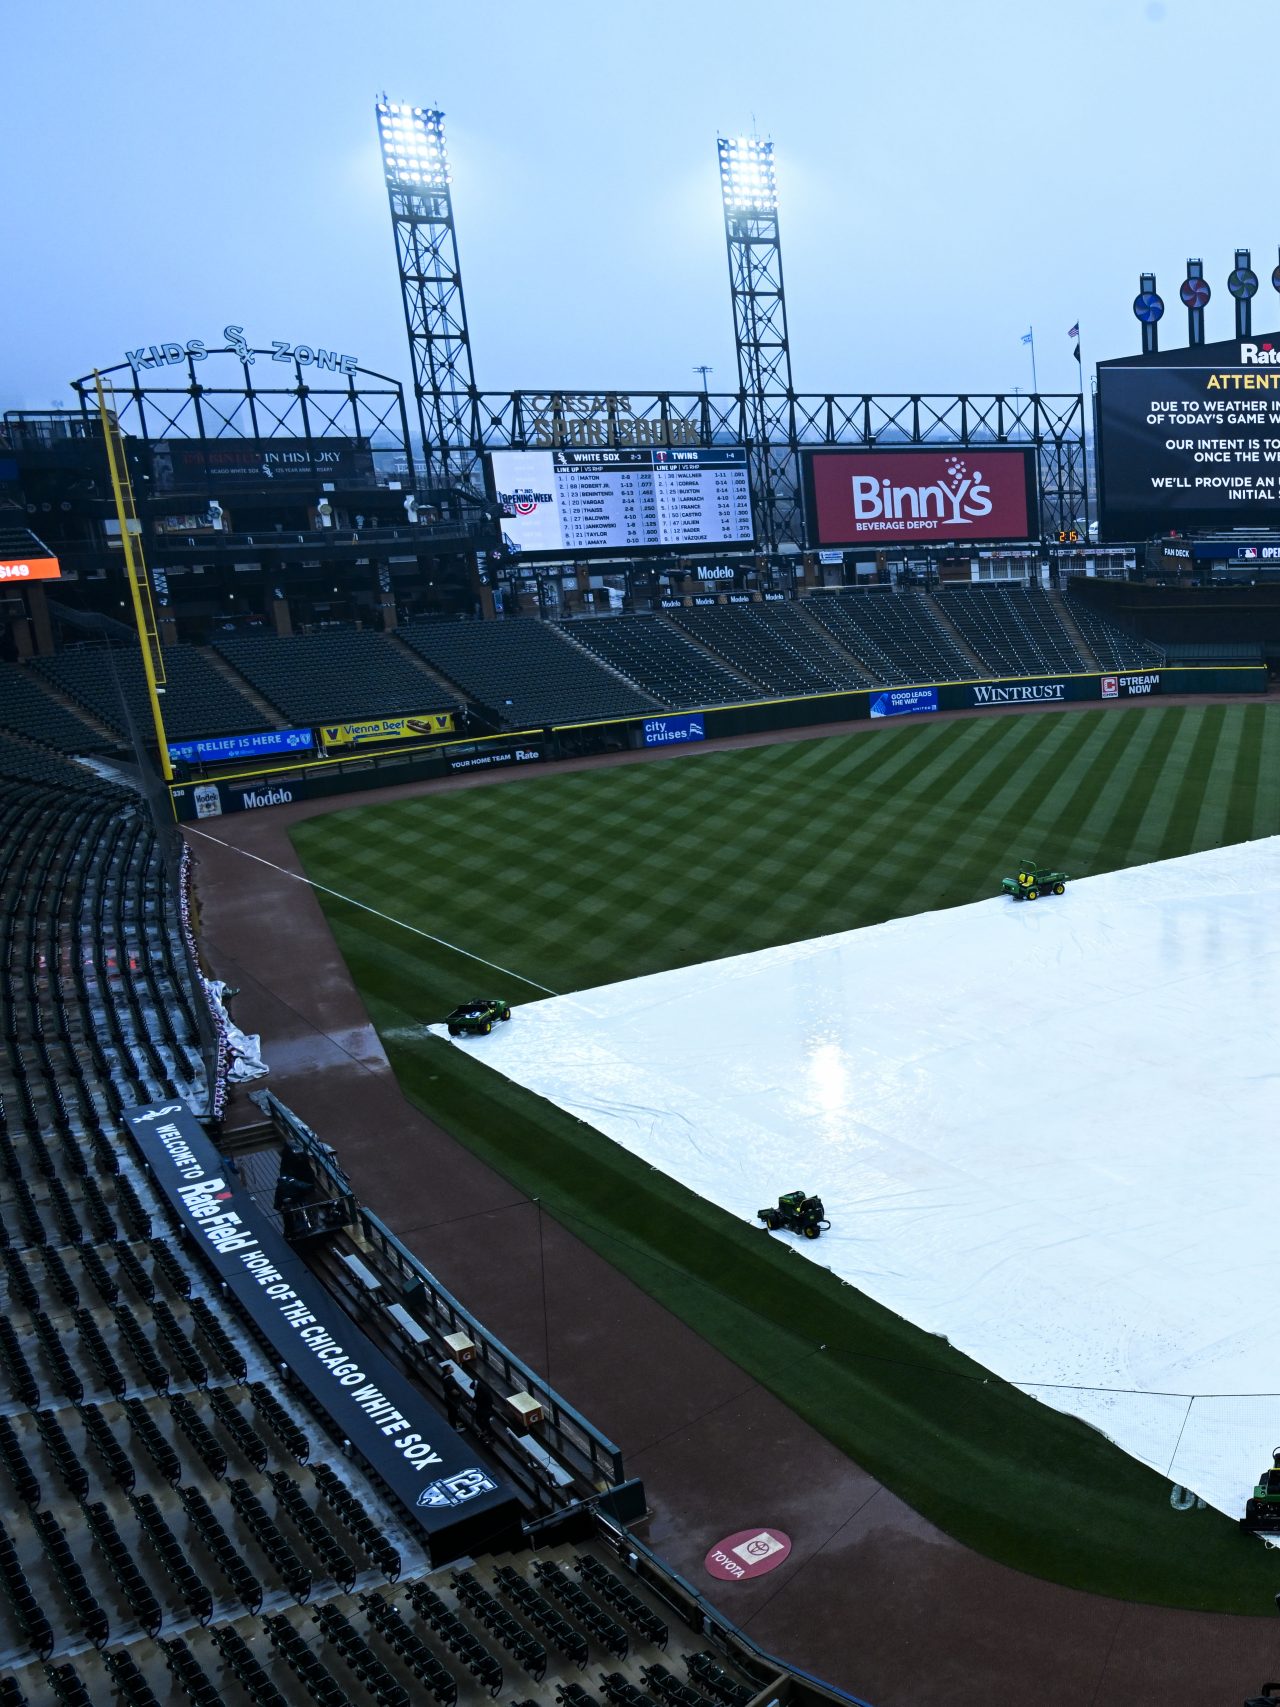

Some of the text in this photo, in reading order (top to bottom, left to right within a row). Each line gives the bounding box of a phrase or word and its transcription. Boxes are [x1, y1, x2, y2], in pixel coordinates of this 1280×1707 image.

[125, 340, 358, 376] KIDS ZONE
[532, 396, 632, 412] CAESARS
[1151, 401, 1178, 411] DUE
[1181, 401, 1199, 411] TO
[1203, 401, 1267, 411] WEATHER
[1147, 414, 1165, 424] OF
[1168, 414, 1223, 424] TODAY'S
[1228, 414, 1265, 424] GAME
[534, 418, 701, 447] SPORTSBOOK
[1166, 440, 1193, 449] OUR
[1198, 439, 1244, 449] INTENT
[1249, 439, 1260, 449] IS
[1264, 439, 1280, 449] TO
[603, 453, 620, 461] SOX
[1194, 452, 1231, 462] ONCE
[1234, 452, 1259, 462] THE
[1151, 478, 1191, 487] WE'LL
[1195, 477, 1252, 487] PROVIDE
[1256, 477, 1274, 487] AN
[533, 493, 553, 502] WEEK
[852, 471, 992, 523] Binny's
[1229, 490, 1275, 499] INITIAL
[856, 521, 938, 531] BEVERAGE DEPOT
[1059, 532, 1077, 542] 2:15
[1165, 548, 1189, 557] FAN DECK
[697, 566, 734, 579] Modelo
[765, 593, 784, 601] Modelo
[662, 600, 681, 608] Modelo
[1120, 675, 1159, 694] STREAM NOW
[973, 684, 1064, 701] WINTRUST
[344, 720, 405, 735] Vienna Beef
[646, 723, 667, 732] city
[647, 730, 687, 742] cruises
[197, 735, 282, 753] RELIEF IS HERE
[451, 760, 470, 768] YOUR
[471, 757, 491, 765] HOME
[516, 750, 539, 760] Rate
[243, 788, 292, 808] Modelo
[155, 1123, 443, 1471] WELCOME TO Rate Field HOME OF THE CHICAGO WHITE SOX
[711, 1550, 745, 1579] TOYOTA
